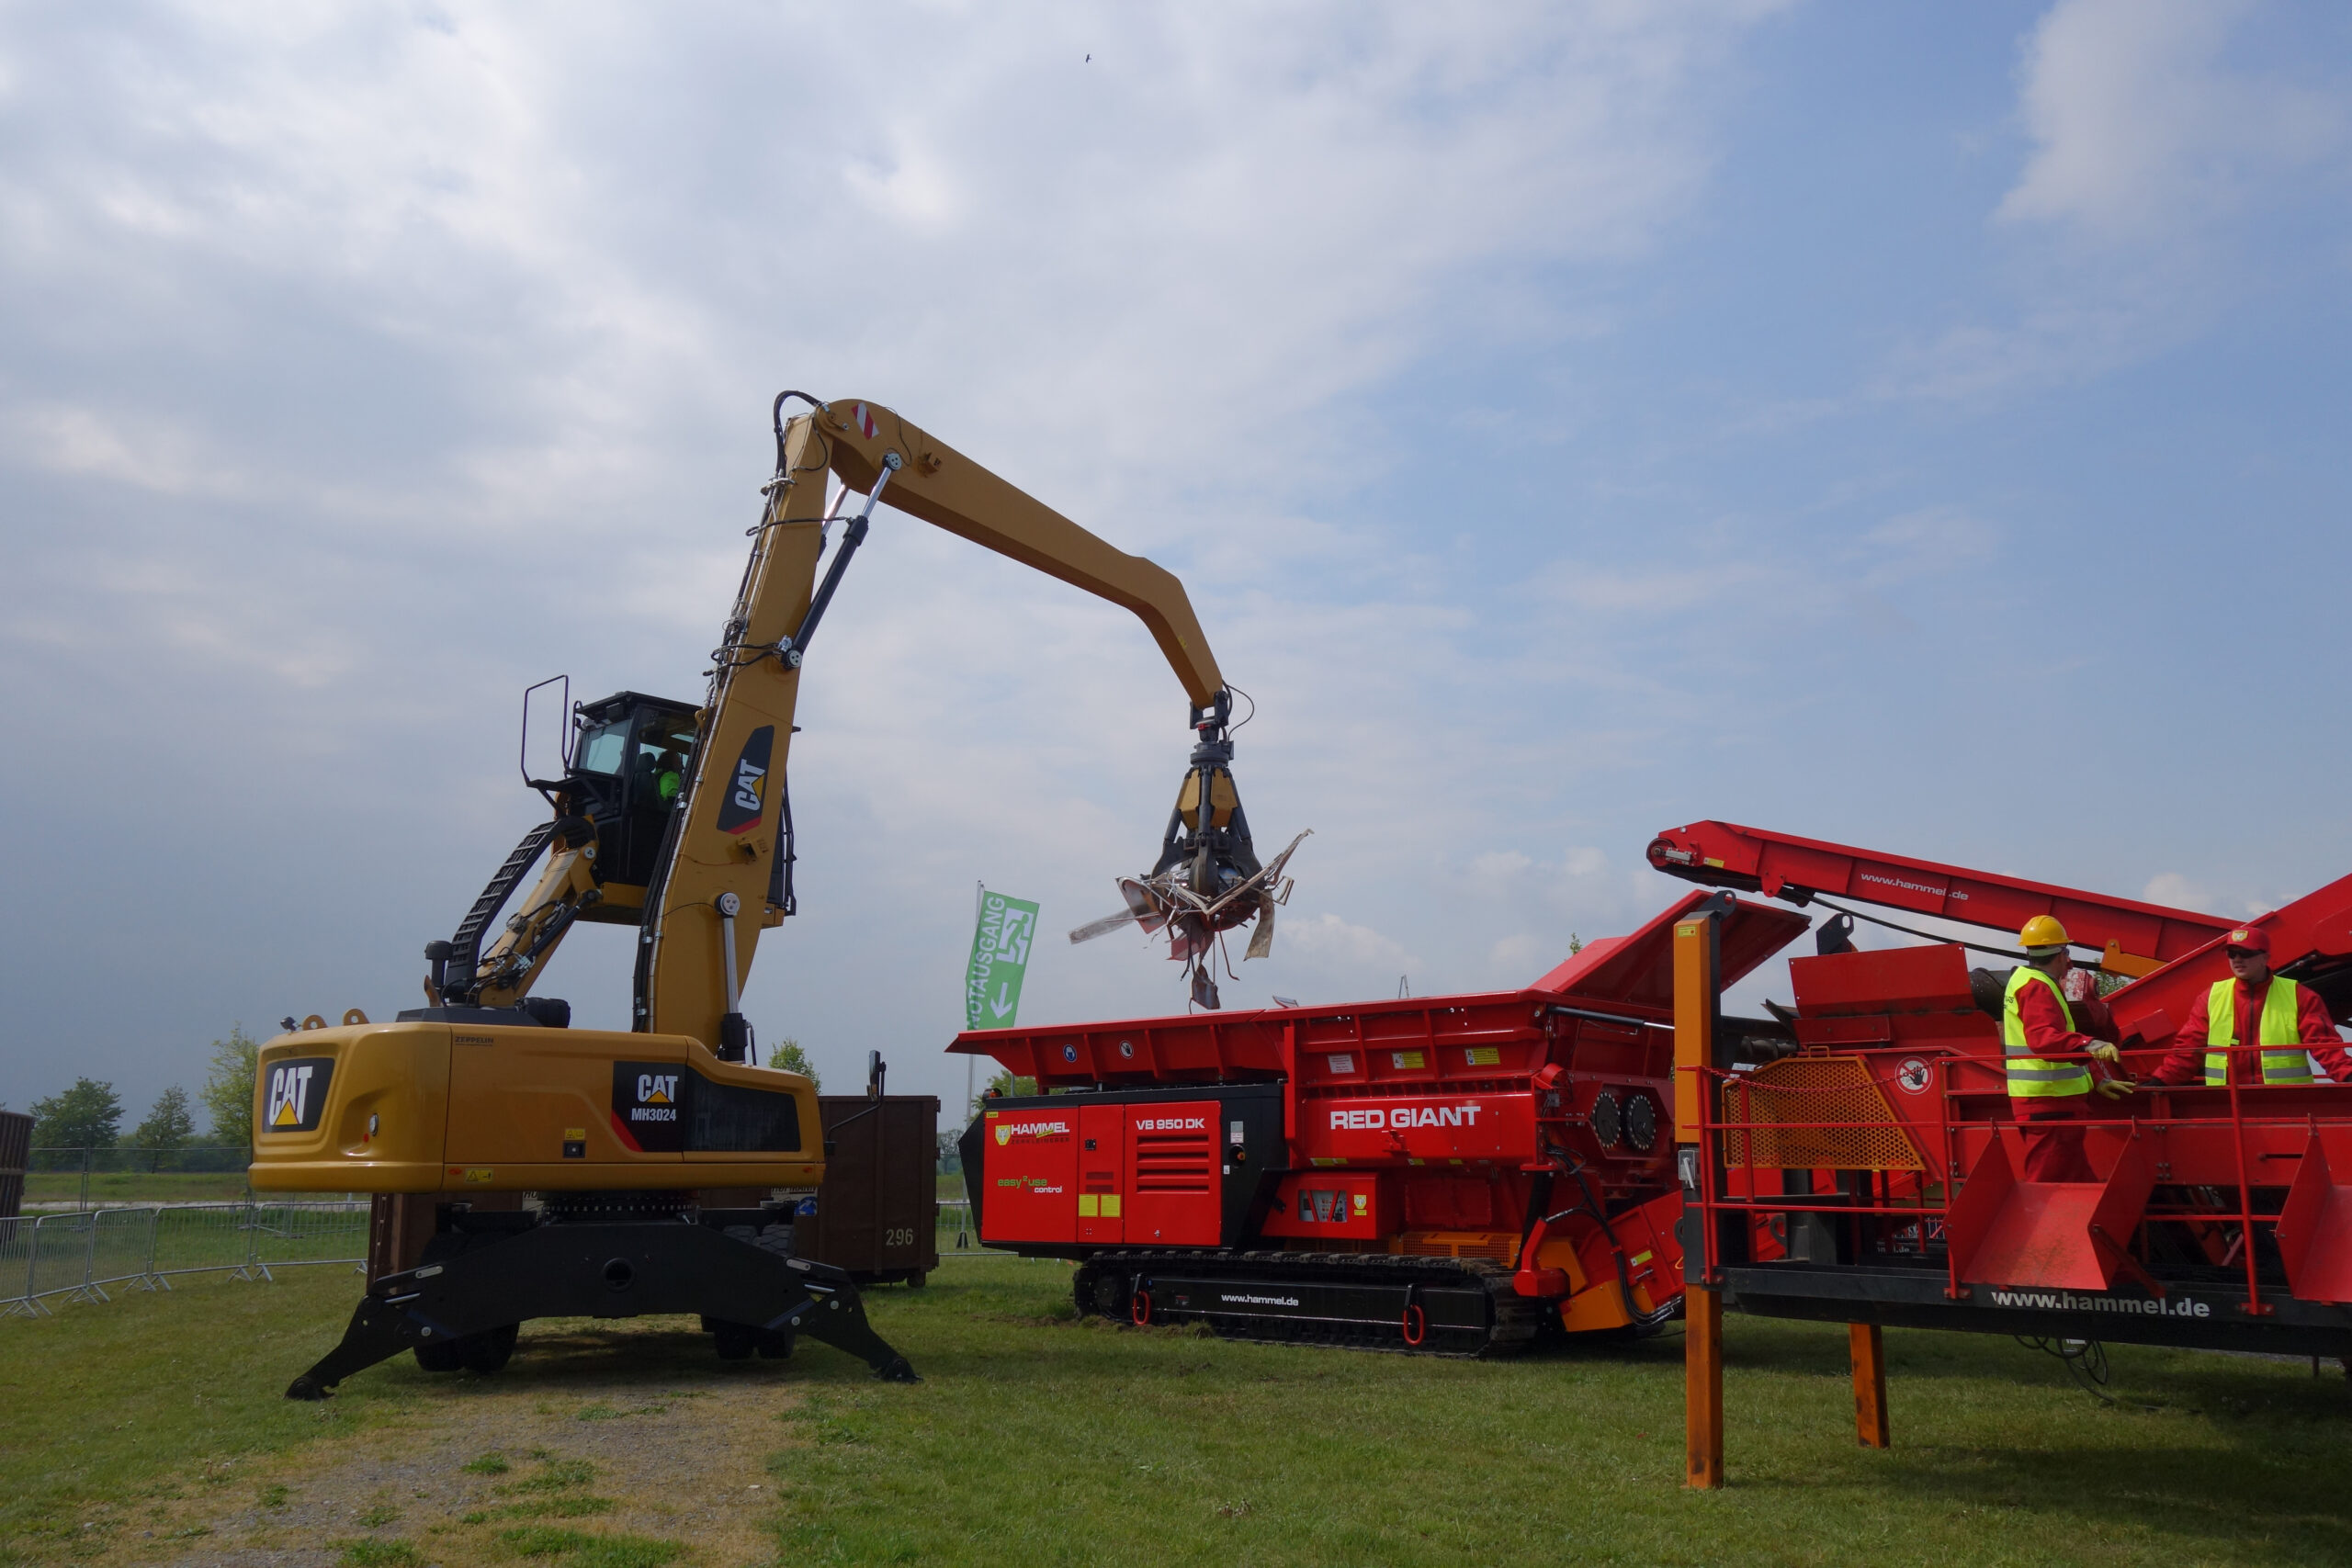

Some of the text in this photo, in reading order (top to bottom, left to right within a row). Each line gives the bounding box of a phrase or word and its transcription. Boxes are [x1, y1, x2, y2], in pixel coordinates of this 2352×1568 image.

[735, 759, 765, 811] CAT
[269, 1066, 313, 1125] CAT
[638, 1074, 679, 1103] CAT
[631, 1108, 677, 1122] MH3024
[1136, 1118, 1205, 1130] VB 950 DK
[1330, 1106, 1481, 1130] RED GIANT
[1011, 1122, 1070, 1135] HAMMEL
[1035, 1185, 1063, 1193] control
[886, 1228, 914, 1247] 296
[1221, 1293, 1299, 1306] www.hammel.de
[1991, 1292, 2211, 1317] www.hammel.de
